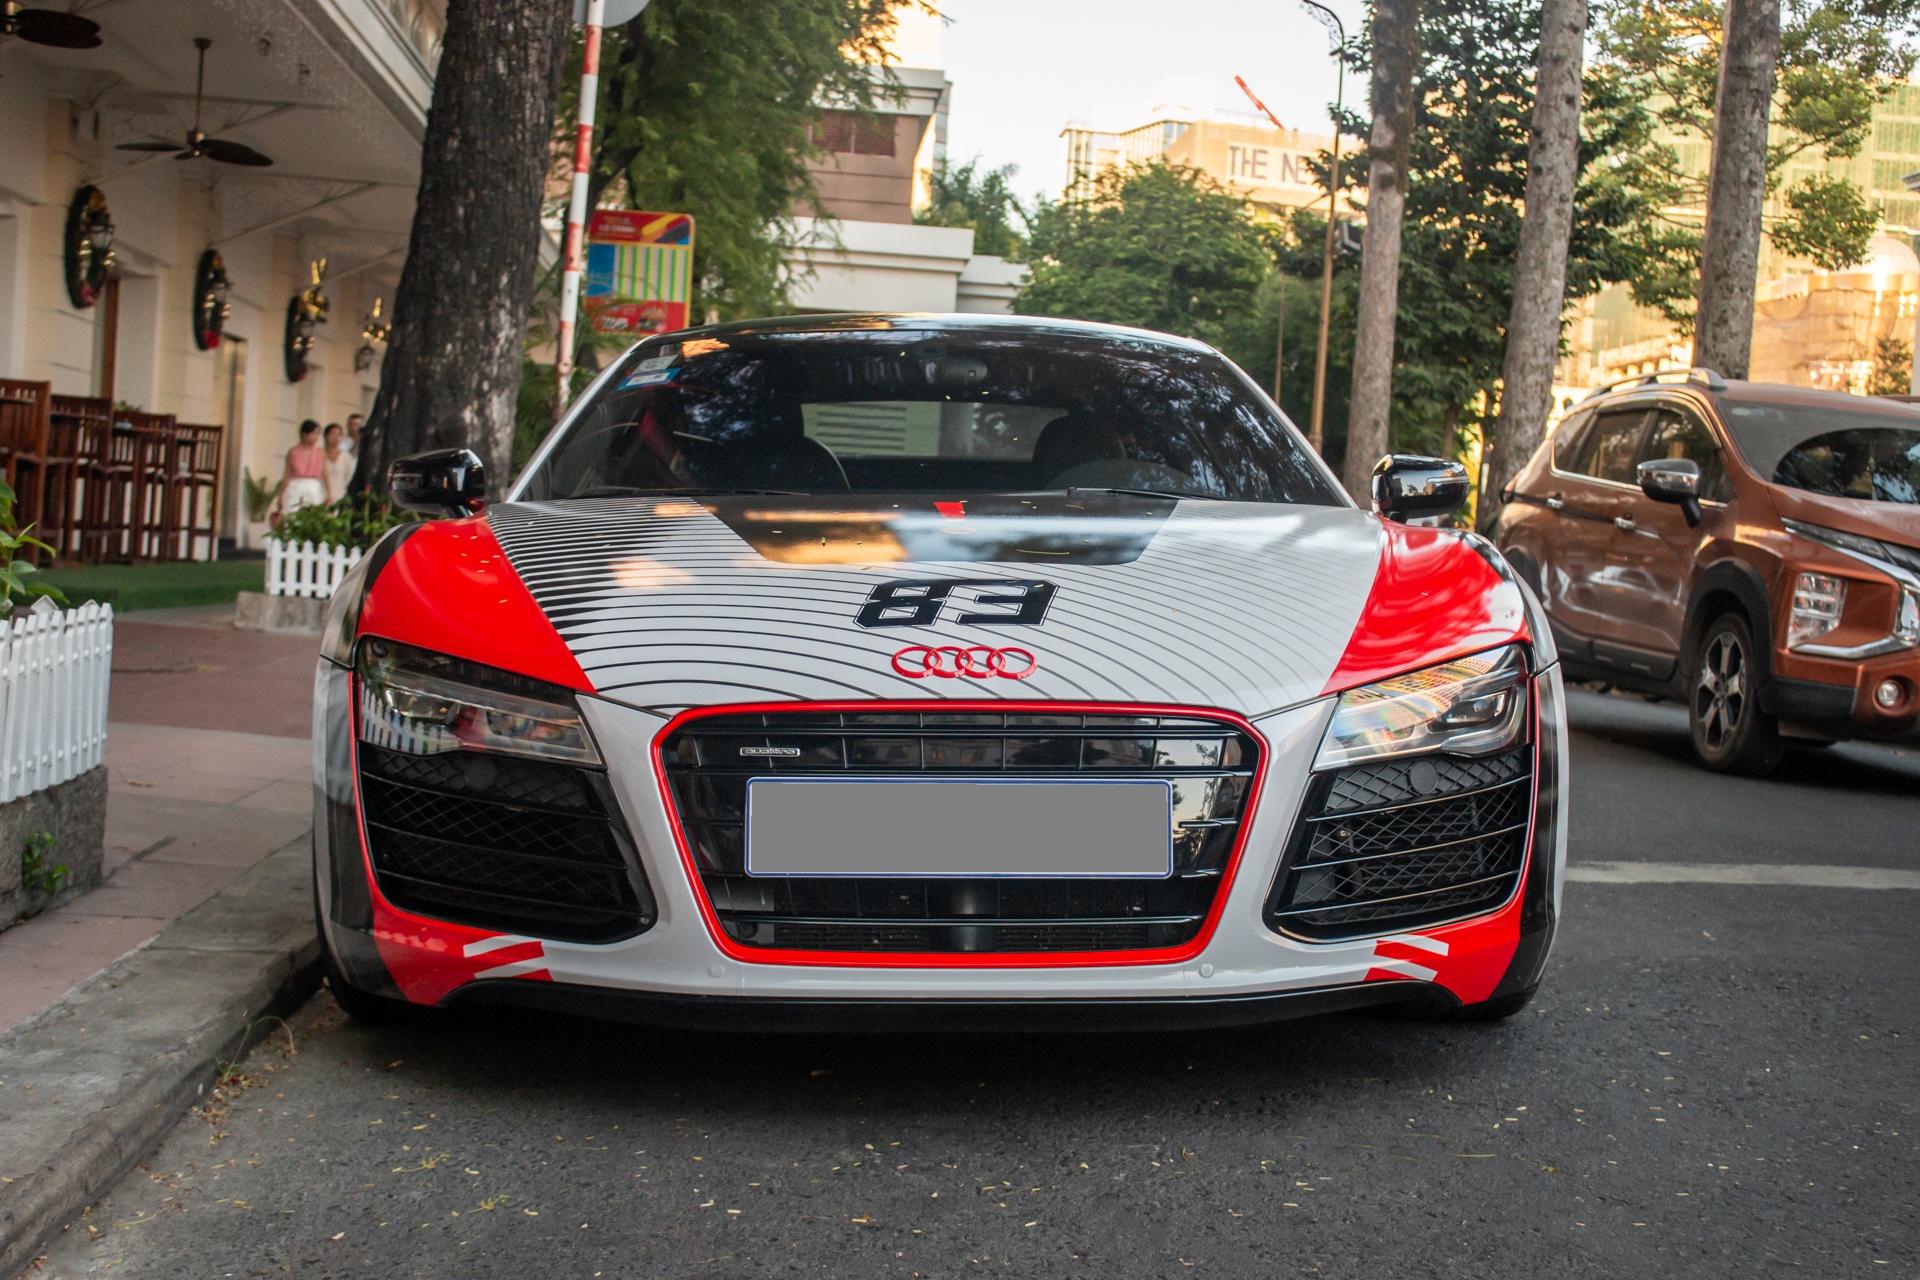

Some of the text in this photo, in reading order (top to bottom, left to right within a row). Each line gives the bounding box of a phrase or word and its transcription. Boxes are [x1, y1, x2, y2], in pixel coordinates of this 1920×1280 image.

[1229, 145, 1313, 186] THE NE
[853, 578, 1060, 629] 83
